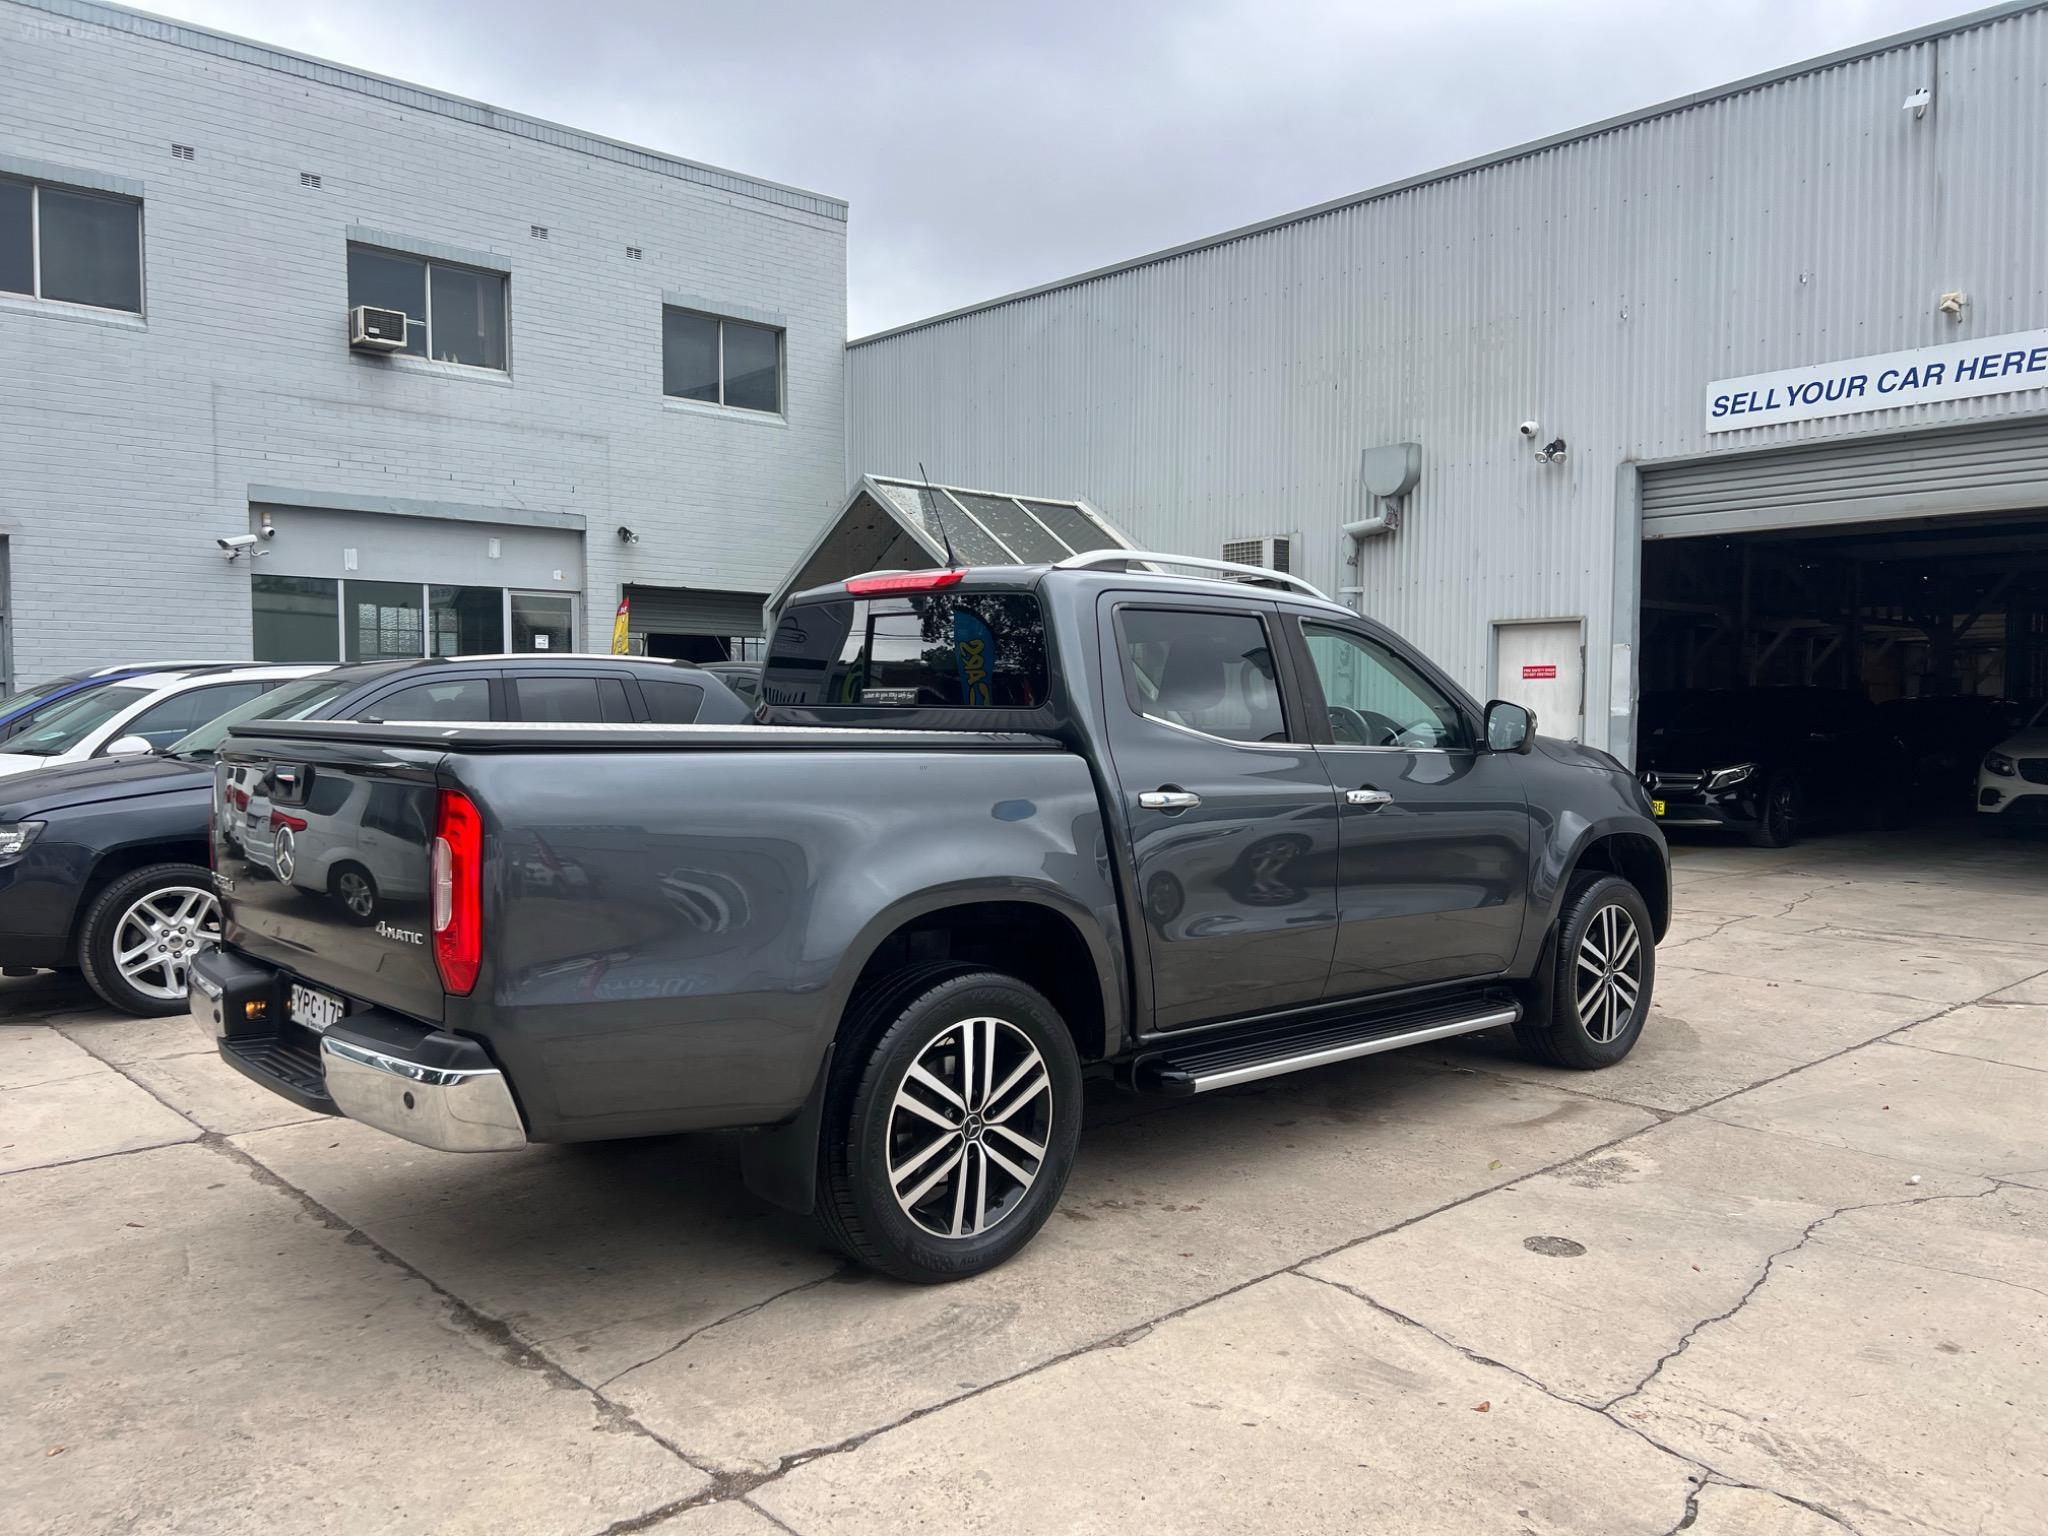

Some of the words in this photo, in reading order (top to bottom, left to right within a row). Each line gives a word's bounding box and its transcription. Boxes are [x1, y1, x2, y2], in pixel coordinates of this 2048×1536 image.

[1711, 388, 1781, 418] SELL
[1786, 374, 1868, 406] YOUR
[1877, 362, 1947, 393] CAR
[1954, 346, 2048, 383] HERE
[375, 920, 424, 945] 4MATIC
